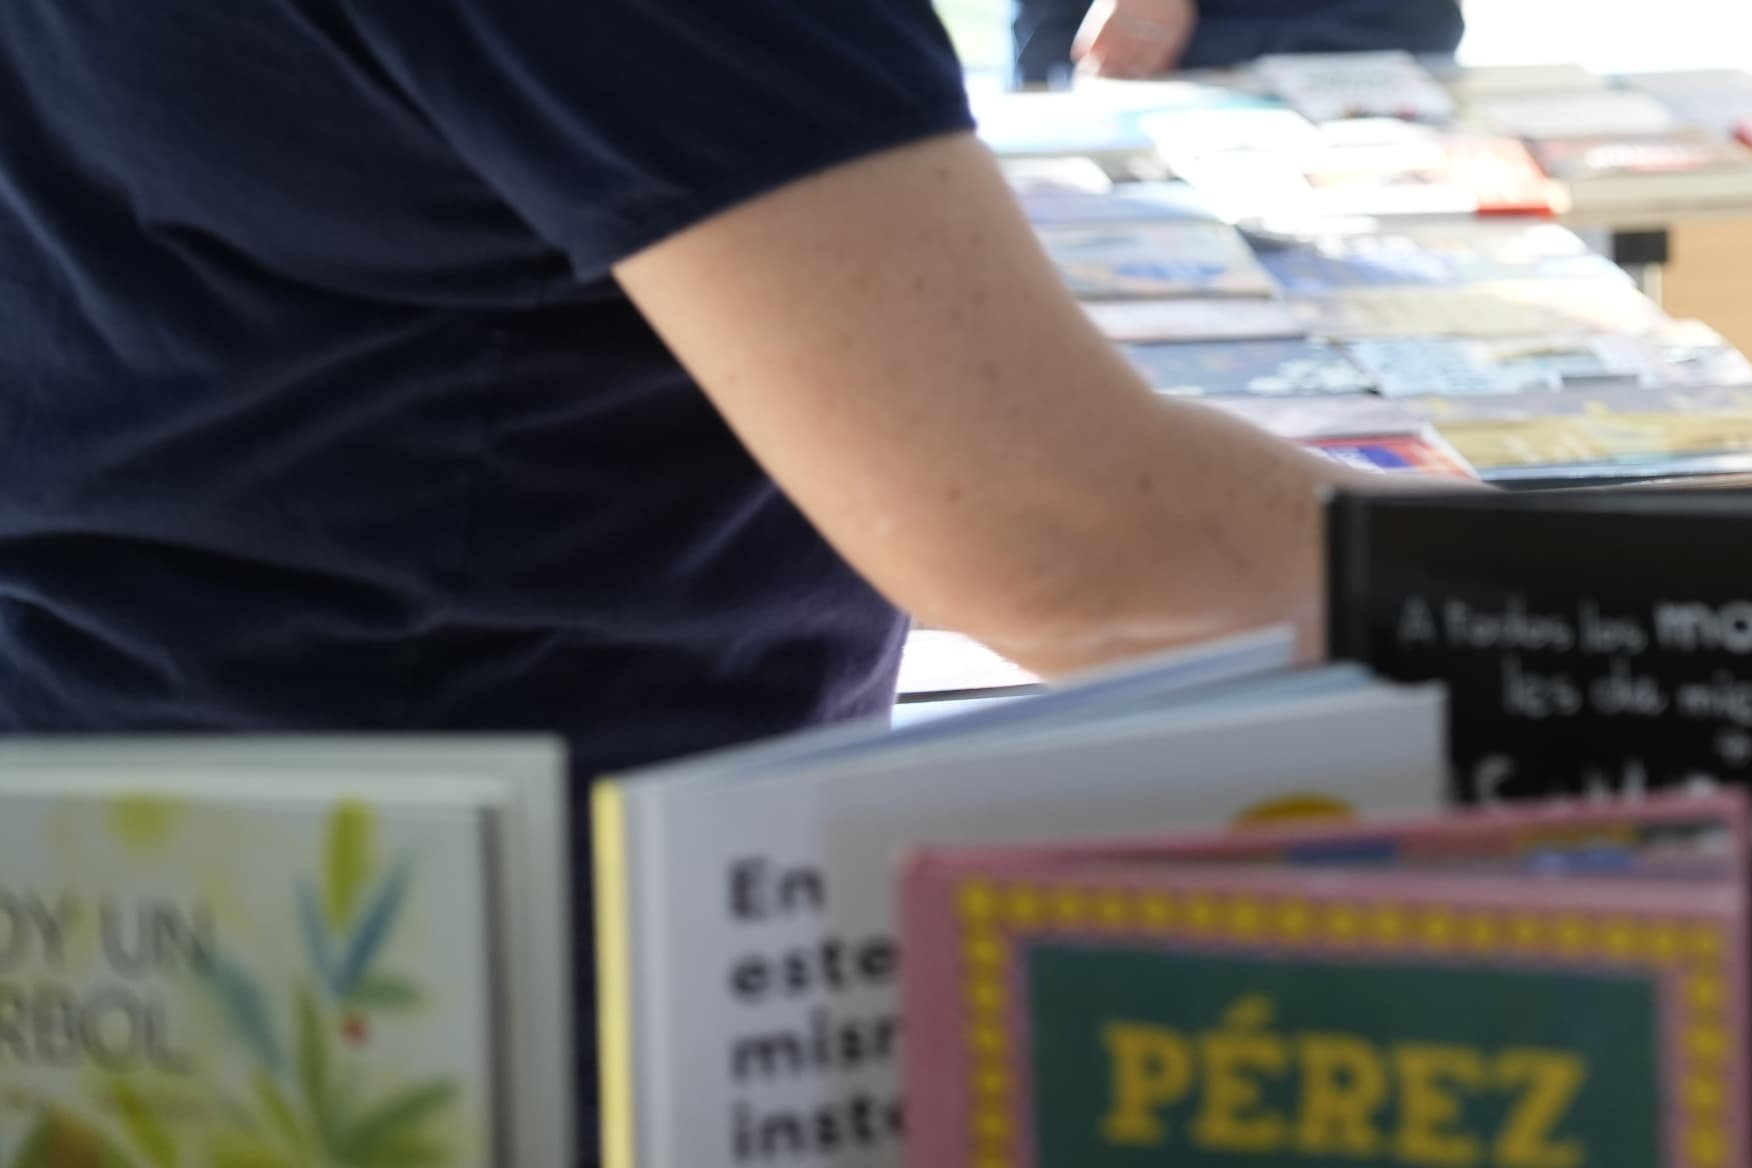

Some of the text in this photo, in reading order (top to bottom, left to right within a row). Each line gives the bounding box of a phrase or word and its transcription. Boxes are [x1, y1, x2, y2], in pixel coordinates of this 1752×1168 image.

[726, 854, 828, 925] En
[728, 934, 905, 1004] este
[1098, 990, 1590, 1168] PÉREZ
